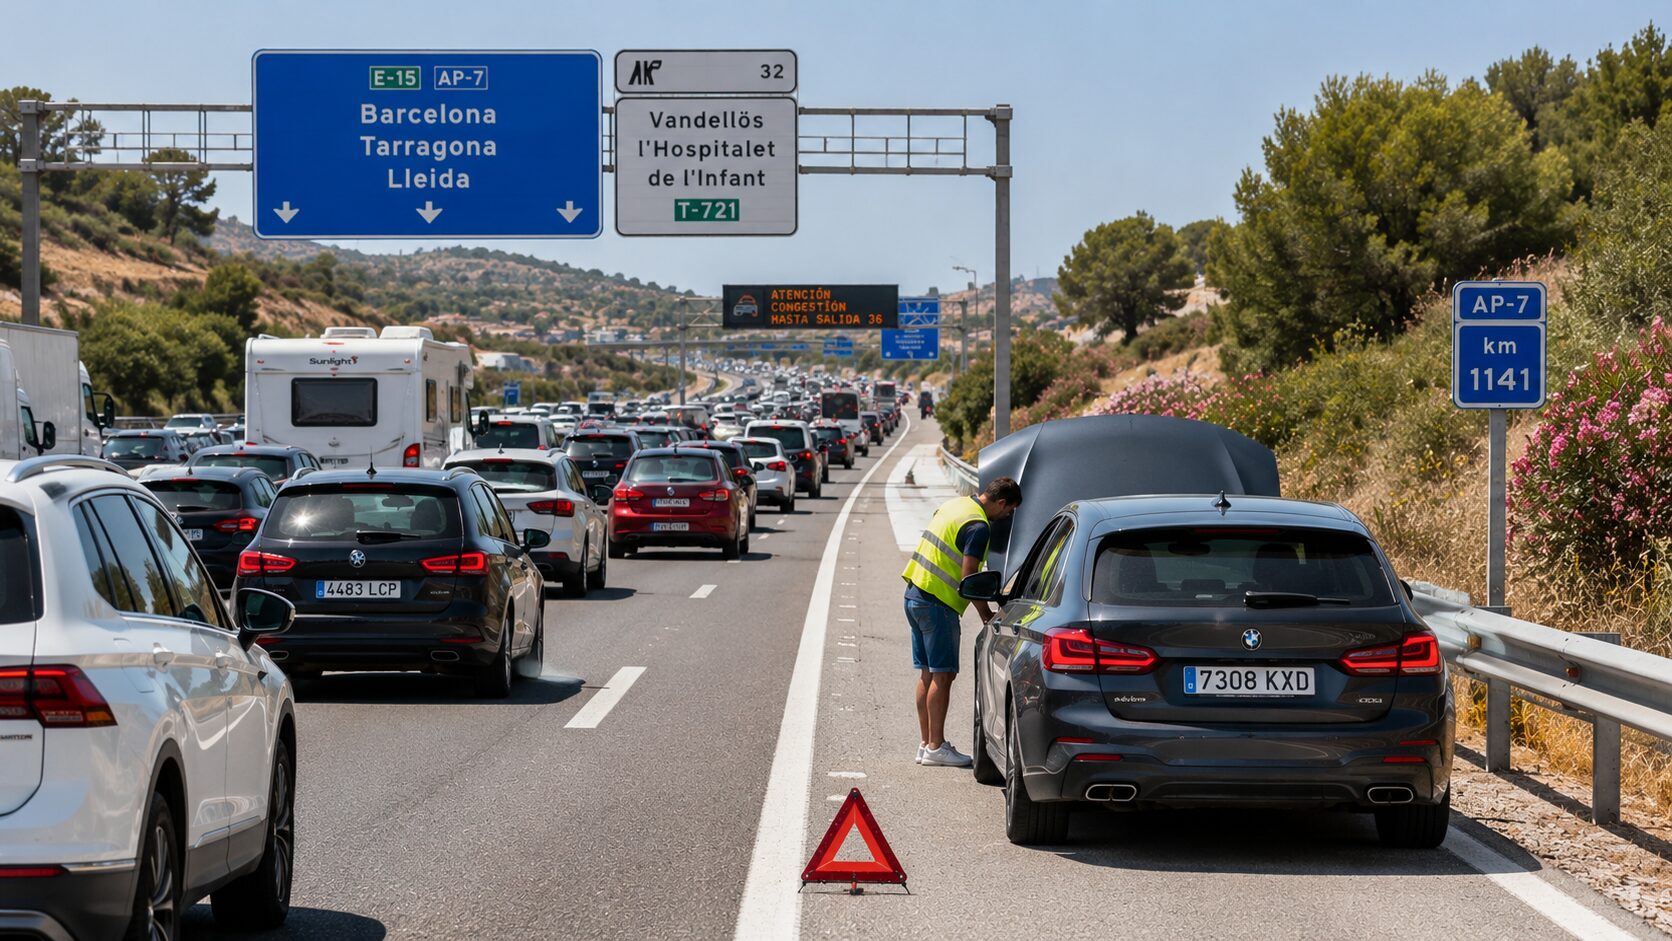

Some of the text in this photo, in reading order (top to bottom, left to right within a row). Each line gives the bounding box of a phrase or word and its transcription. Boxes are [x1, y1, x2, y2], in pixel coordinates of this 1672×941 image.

[374, 70, 484, 86] E-15 AP-7
[760, 64, 784, 79] 32
[361, 103, 497, 124] Barcelona
[649, 111, 764, 129] Vandellös
[360, 135, 497, 161] Tarragona
[639, 140, 775, 162] l'Hospitalet
[388, 168, 470, 189] Lleida
[648, 169, 766, 187] de l'Infant
[678, 201, 735, 219] T-721
[771, 287, 831, 300] ATENCIÓN
[1472, 295, 1530, 314] AP-7
[771, 314, 883, 325] HASTA SALIDA 36
[1483, 337, 1517, 354] km
[309, 357, 352, 366] Sunlight
[1470, 367, 1530, 391] 1141
[326, 582, 397, 596] 4483 LCP
[1200, 670, 1309, 691] 7308 KXD
